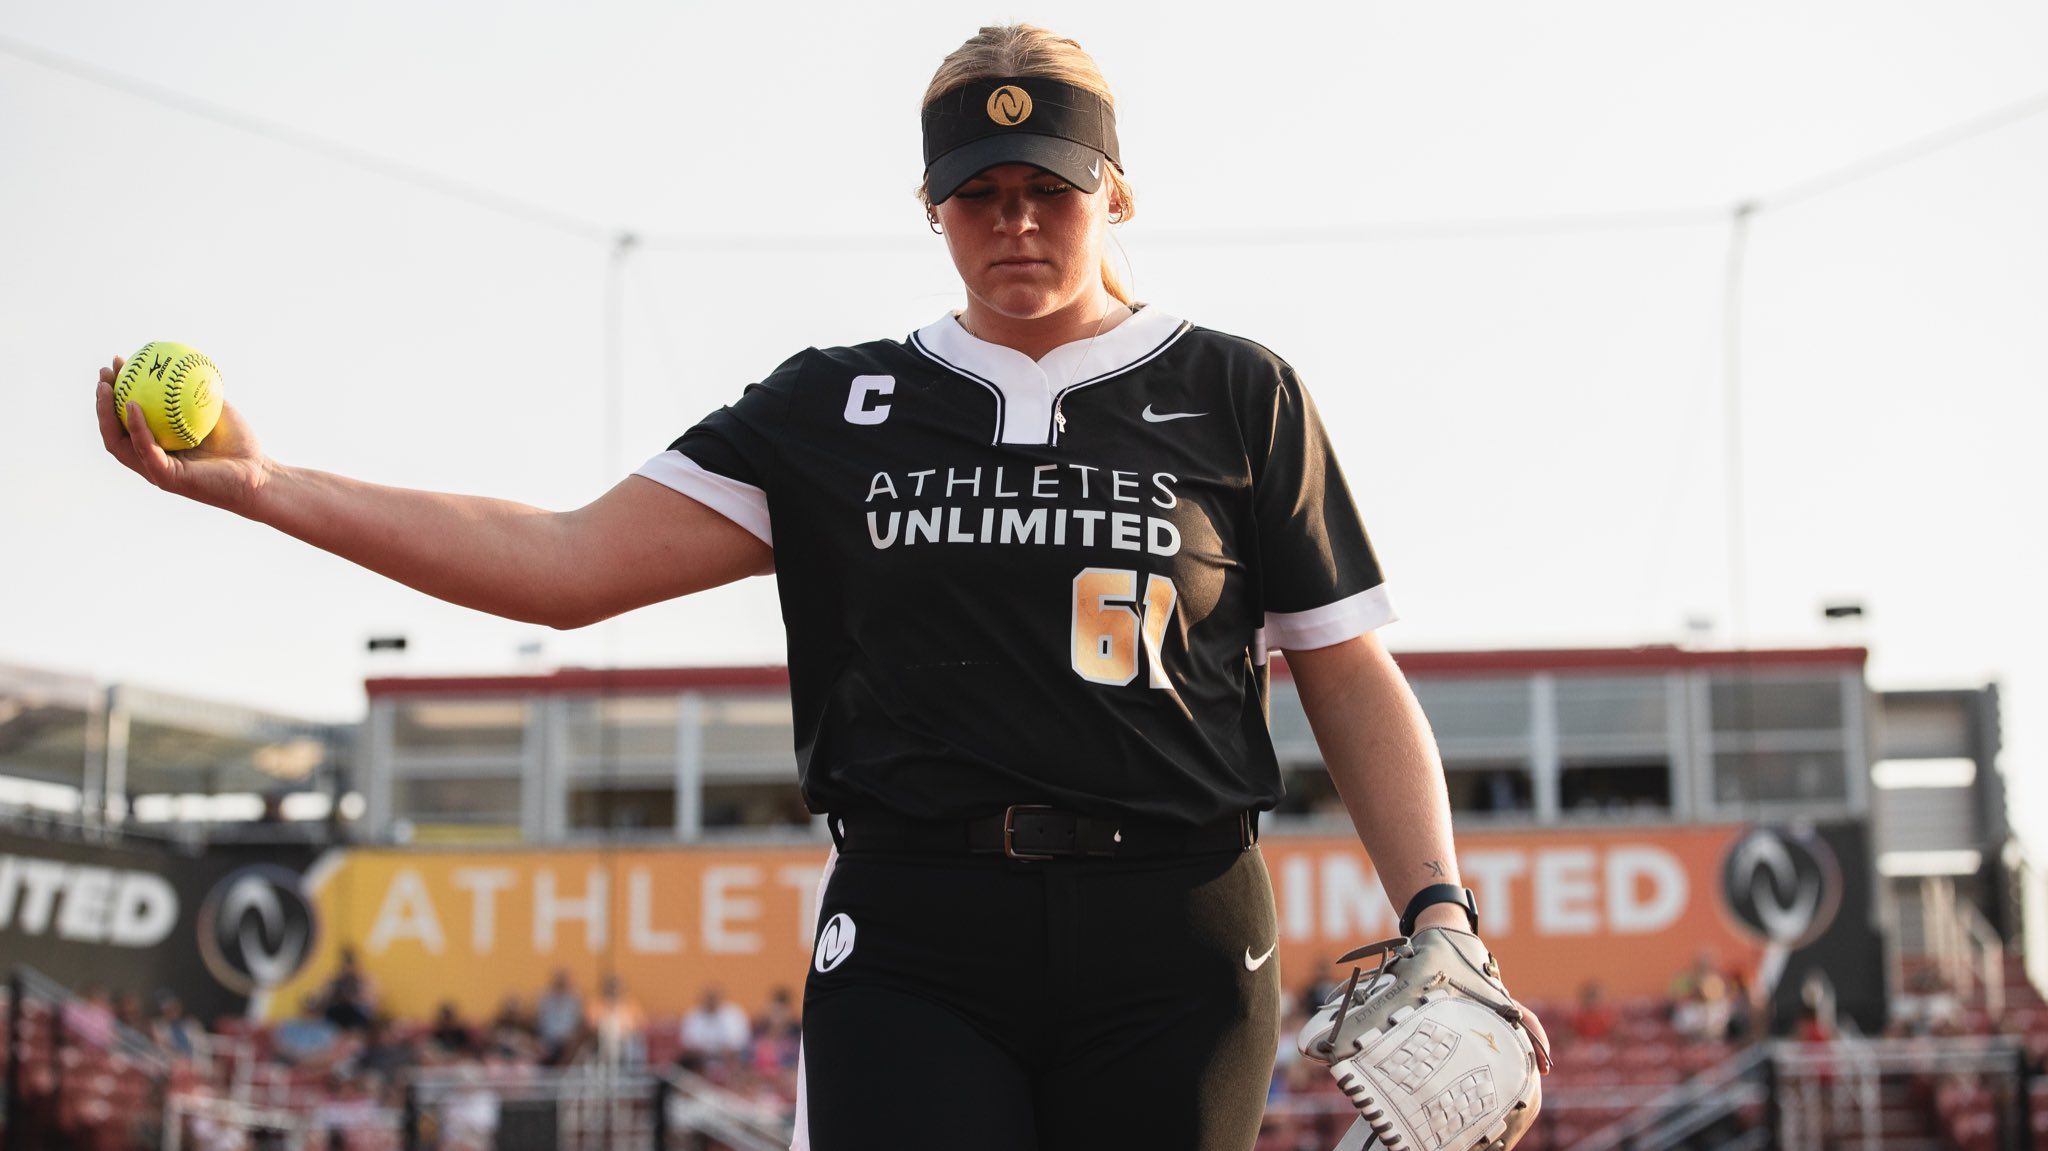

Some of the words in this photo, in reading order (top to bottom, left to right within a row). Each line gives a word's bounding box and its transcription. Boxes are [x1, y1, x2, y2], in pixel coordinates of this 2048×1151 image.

[844, 375, 896, 425] C
[865, 464, 1179, 509] ATHLETES
[866, 507, 1182, 557] UNLIMITED
[1281, 847, 1690, 943] IMTED
